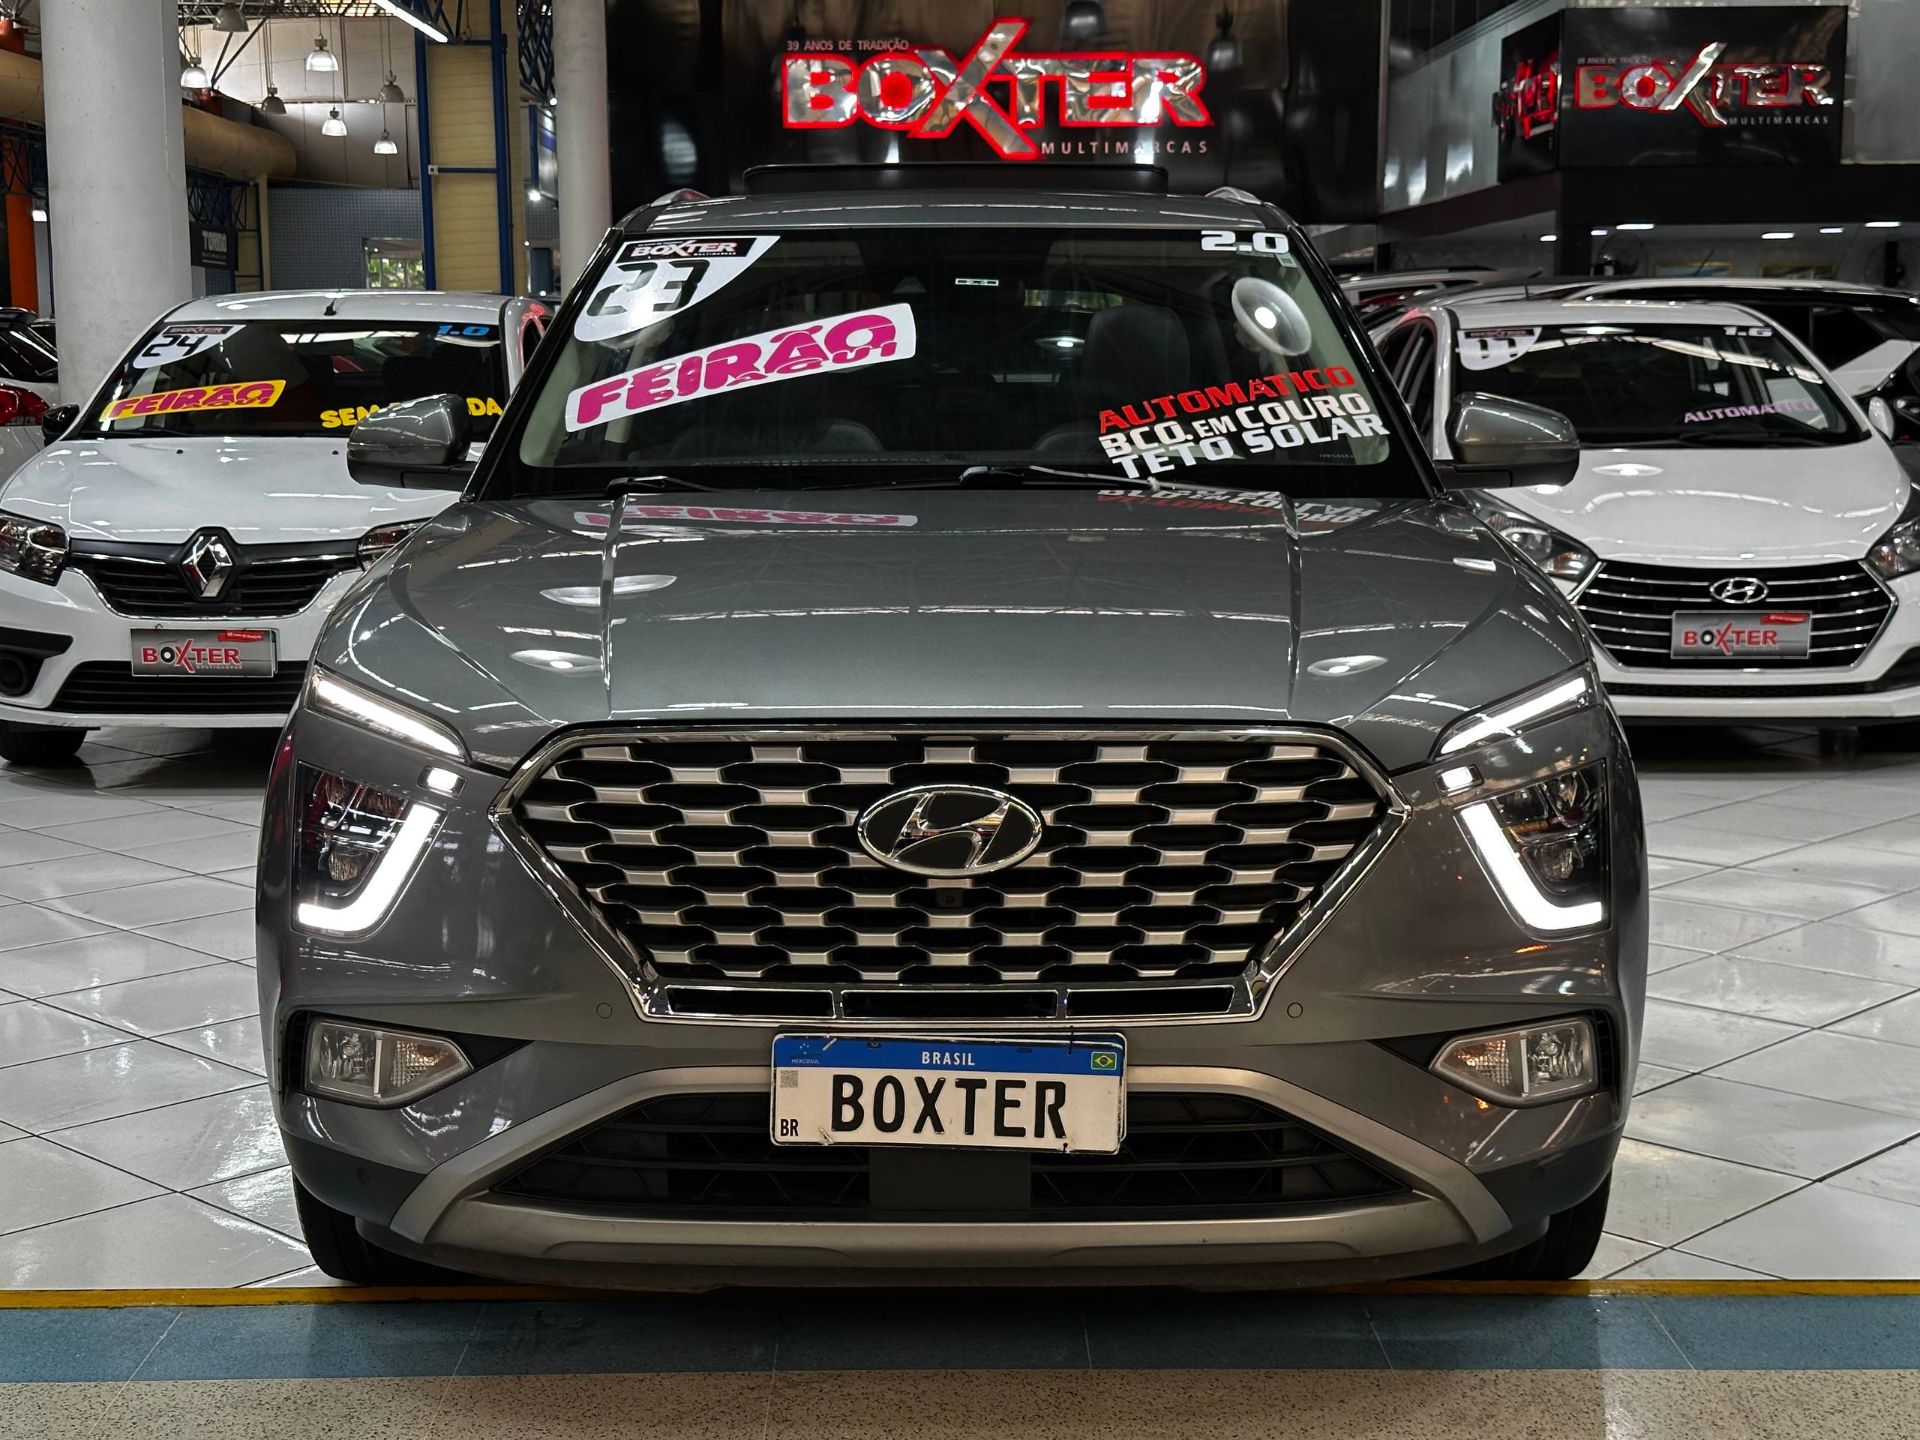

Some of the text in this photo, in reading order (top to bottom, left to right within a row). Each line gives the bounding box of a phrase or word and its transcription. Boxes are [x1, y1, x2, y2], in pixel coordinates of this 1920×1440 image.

[787, 38, 909, 52] 39 ANOS DE TRADIÇÃO
[783, 16, 1215, 160] BOXTER
[1575, 42, 1834, 127] BOXTER
[1729, 116, 1829, 126] MULTIMARCAS
[1041, 141, 1207, 155] MULTIMARCAS
[631, 240, 738, 257] BOXTER
[1201, 230, 1289, 254] 2.0
[586, 259, 710, 317] 23
[141, 335, 208, 357] 24
[437, 325, 490, 336] 1.0
[577, 314, 897, 424] FEIRÃO
[109, 383, 275, 418] FEIRÃO
[1192, 415, 1236, 438] EM
[1235, 392, 1371, 428] COURO
[1111, 413, 1391, 479] TETO SOLAR
[141, 638, 242, 673] BOXTER
[1682, 621, 1778, 656] BOXTER
[921, 1051, 976, 1066] BRASIL
[831, 1073, 1068, 1139] BOXTER
[780, 1118, 799, 1137] BR
